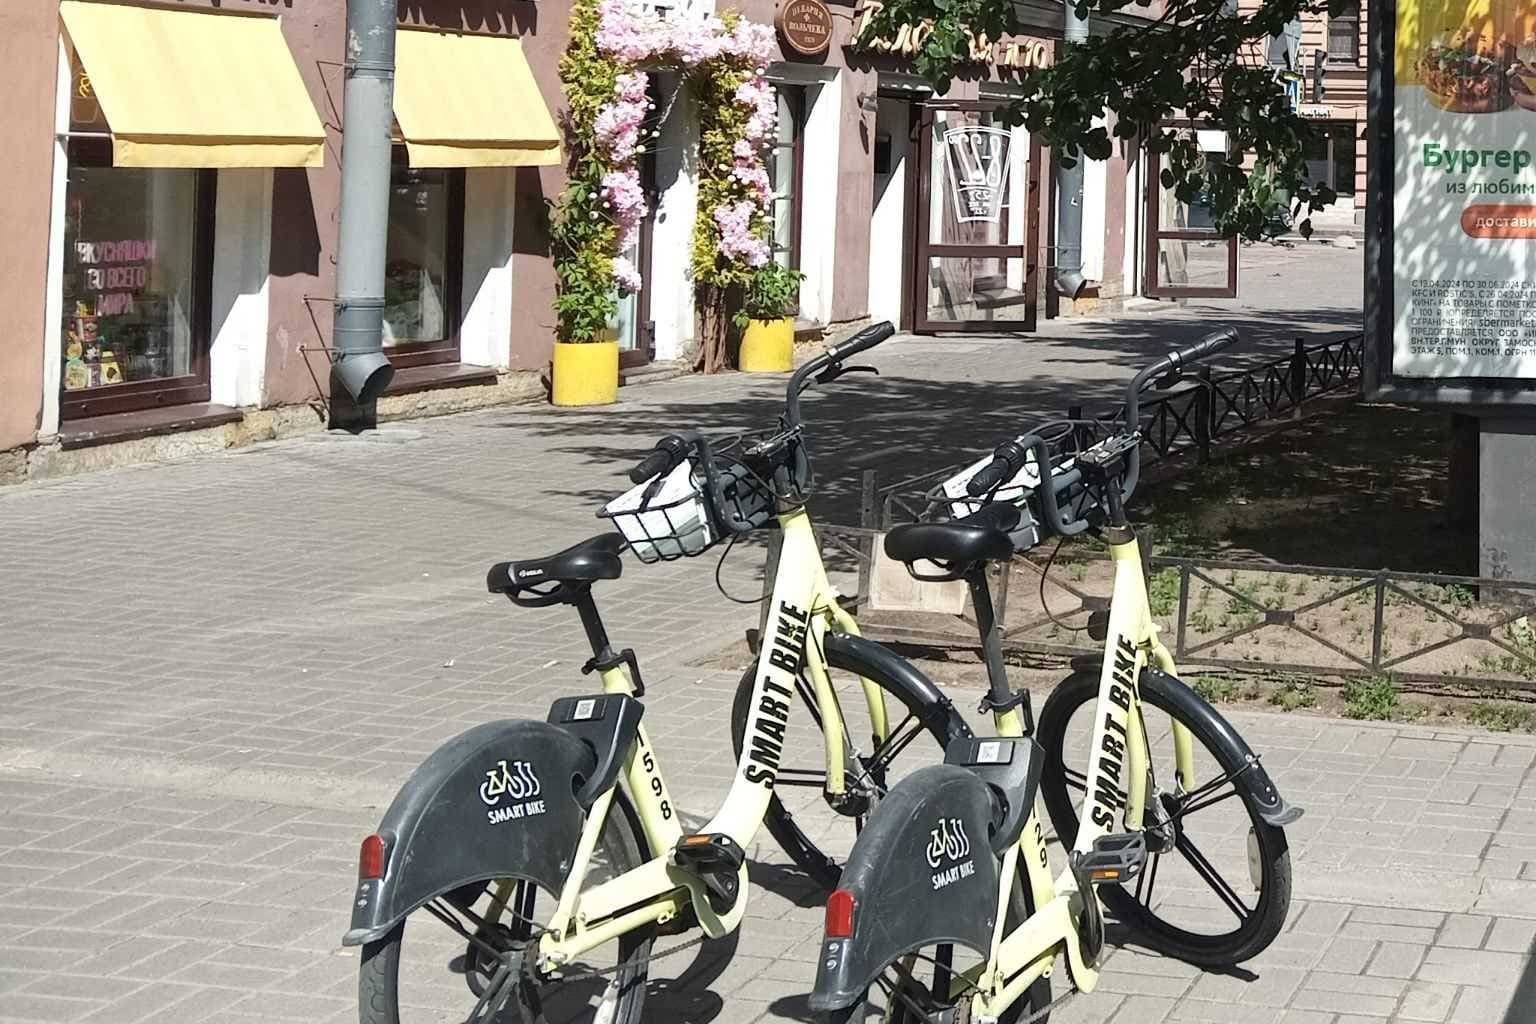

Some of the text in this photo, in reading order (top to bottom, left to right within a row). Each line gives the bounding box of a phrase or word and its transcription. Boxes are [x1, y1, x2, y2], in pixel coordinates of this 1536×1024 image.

[789, 21, 826, 34] ВОЛЬЧЕКА
[1422, 144, 1530, 174] Бургер
[1446, 181, 1466, 194] из
[745, 600, 808, 790] SMART BIKE
[1092, 634, 1137, 833] SMART BIKE
[488, 800, 546, 824] SMART BIKE
[932, 860, 975, 890] SMART BIKE
